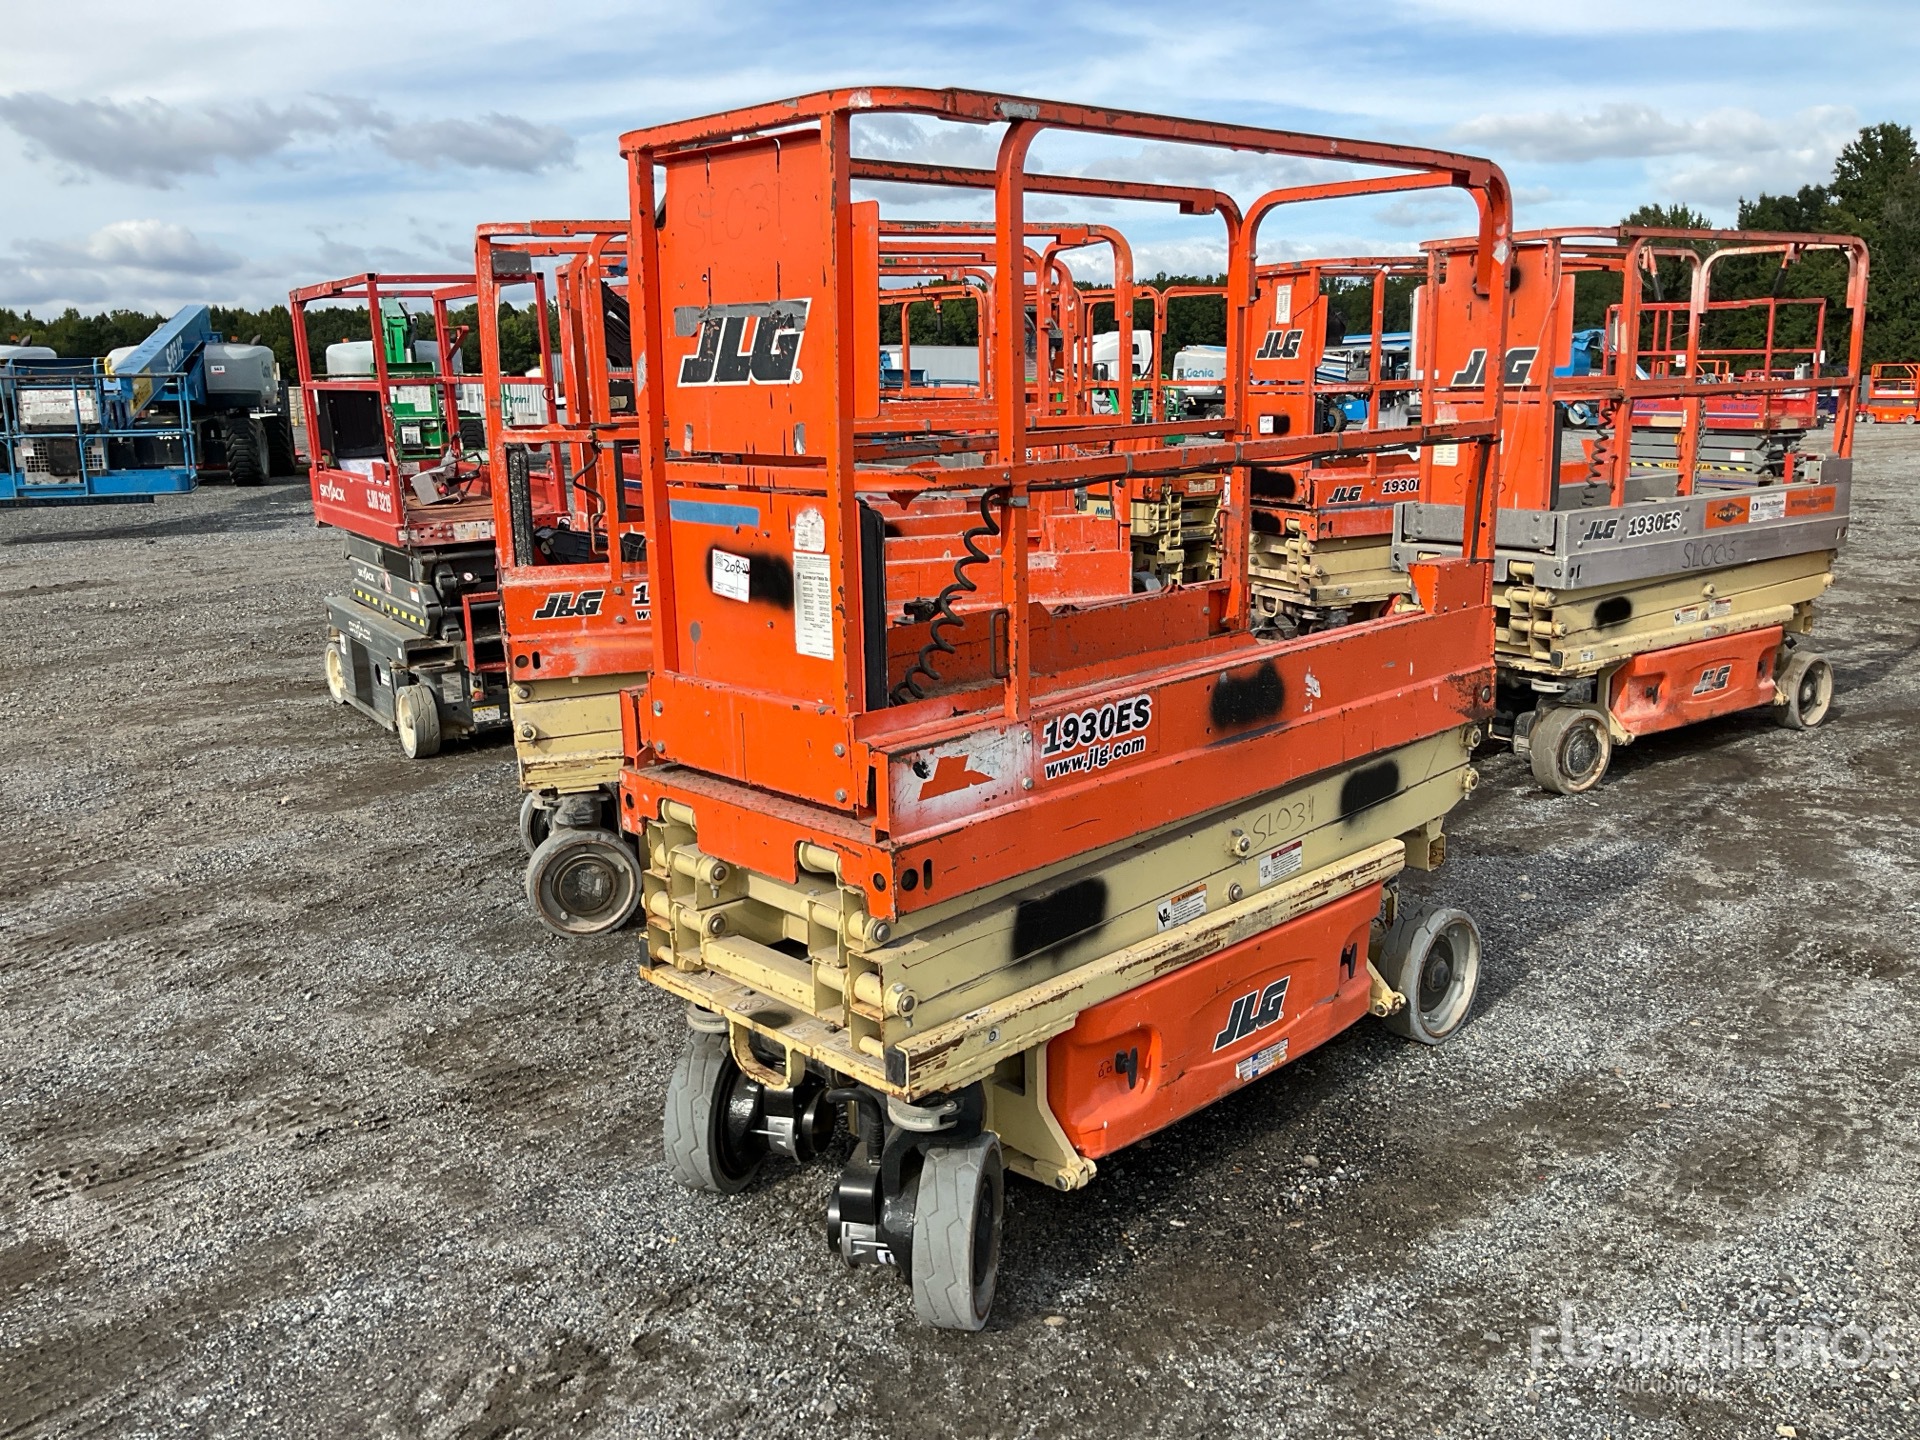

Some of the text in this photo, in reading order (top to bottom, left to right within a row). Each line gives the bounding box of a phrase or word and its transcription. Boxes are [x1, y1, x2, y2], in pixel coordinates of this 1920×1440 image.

[677, 298, 813, 388] JLG
[1255, 330, 1304, 360] JLG
[1186, 367, 1215, 378] Genie
[1450, 347, 1538, 387] JG
[1327, 485, 1364, 504] JLG
[1582, 510, 1682, 541] JLG 1930ES
[533, 590, 605, 620] JLG
[1042, 696, 1153, 757] 1930ES
[1044, 735, 1146, 780] www.jlg.com
[1212, 974, 1291, 1053] JLG
